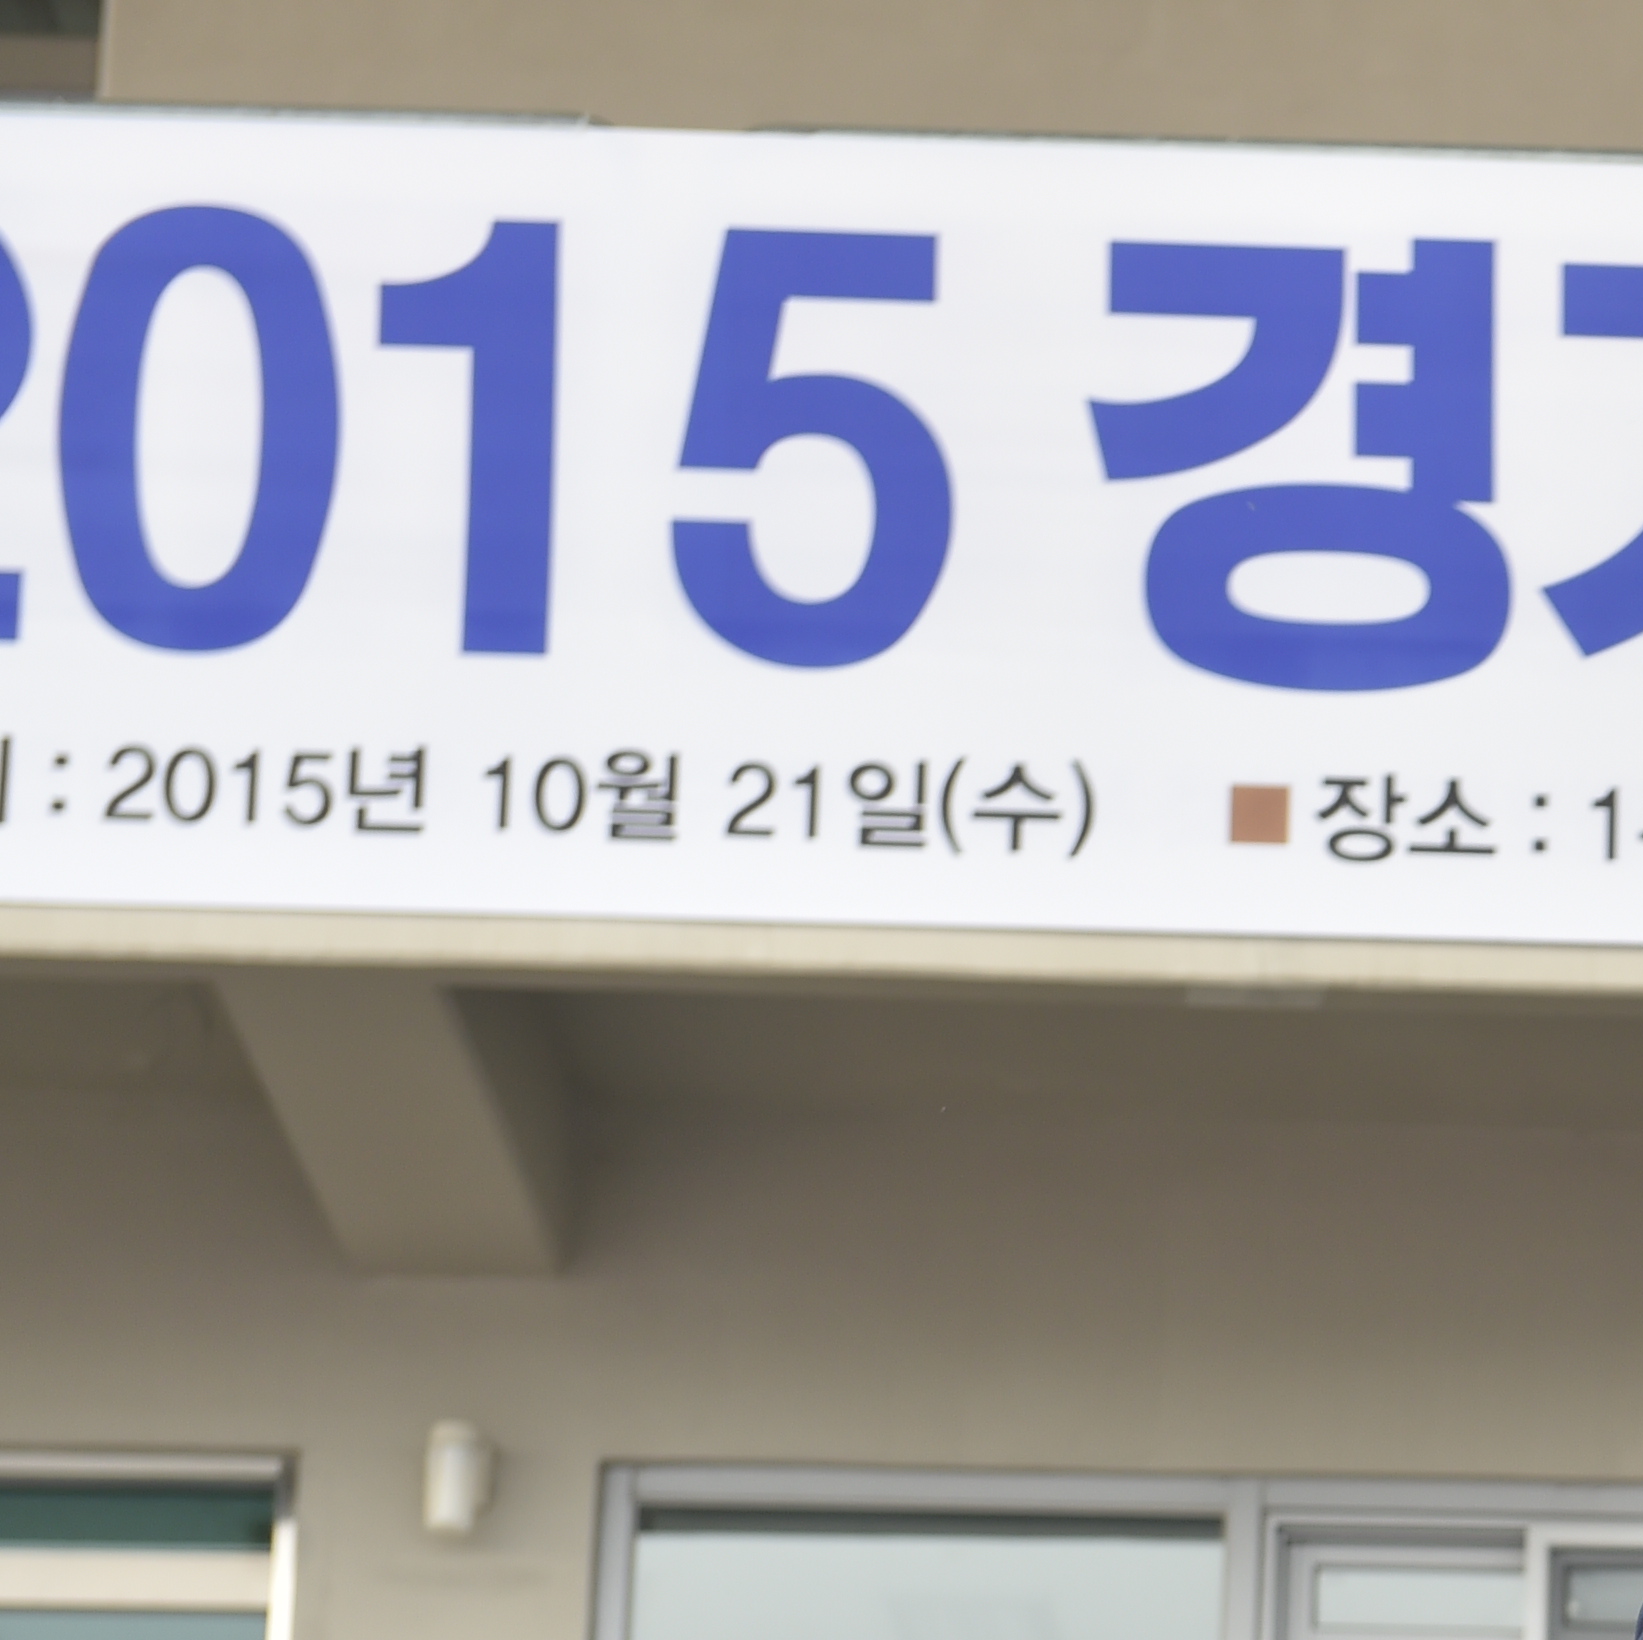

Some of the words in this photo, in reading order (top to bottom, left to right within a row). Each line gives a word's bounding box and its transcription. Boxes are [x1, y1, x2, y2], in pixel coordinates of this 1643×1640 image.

[0, 205, 954, 670] 015
[105, 746, 426, 833] 2015년
[486, 751, 678, 841] 10월
[726, 759, 1094, 857] 21일(수)
[1318, 775, 1495, 862] 장소
